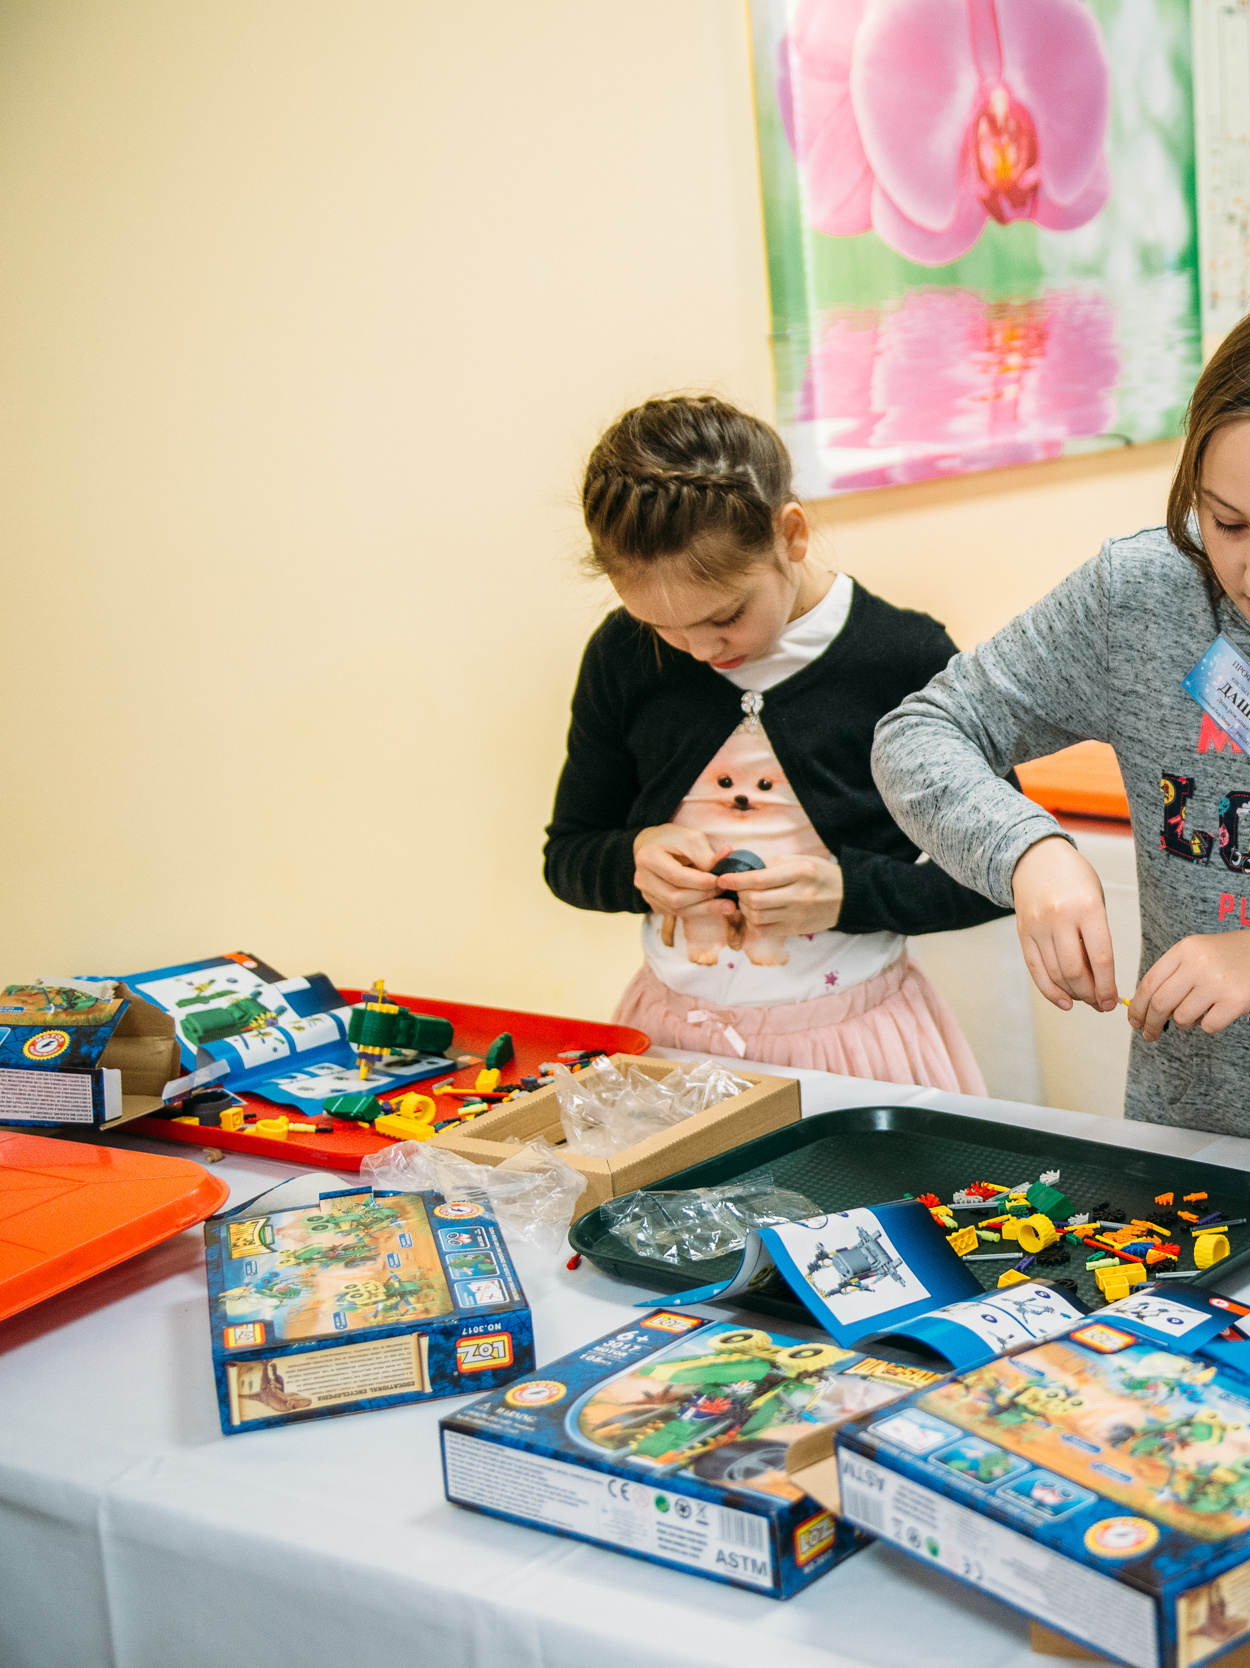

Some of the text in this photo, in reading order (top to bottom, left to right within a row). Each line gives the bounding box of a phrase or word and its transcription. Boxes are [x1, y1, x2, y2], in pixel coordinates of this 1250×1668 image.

[462, 1323, 501, 1335] NO.3017
[650, 1315, 691, 1330] LOZ
[616, 1330, 649, 1342] 6+
[457, 1340, 506, 1364] LOZ
[602, 1340, 641, 1352] 3017
[371, 1381, 415, 1393] EDUCATIONAL
[800, 1516, 834, 1554] LOZ
[715, 1548, 768, 1577] ASTM
